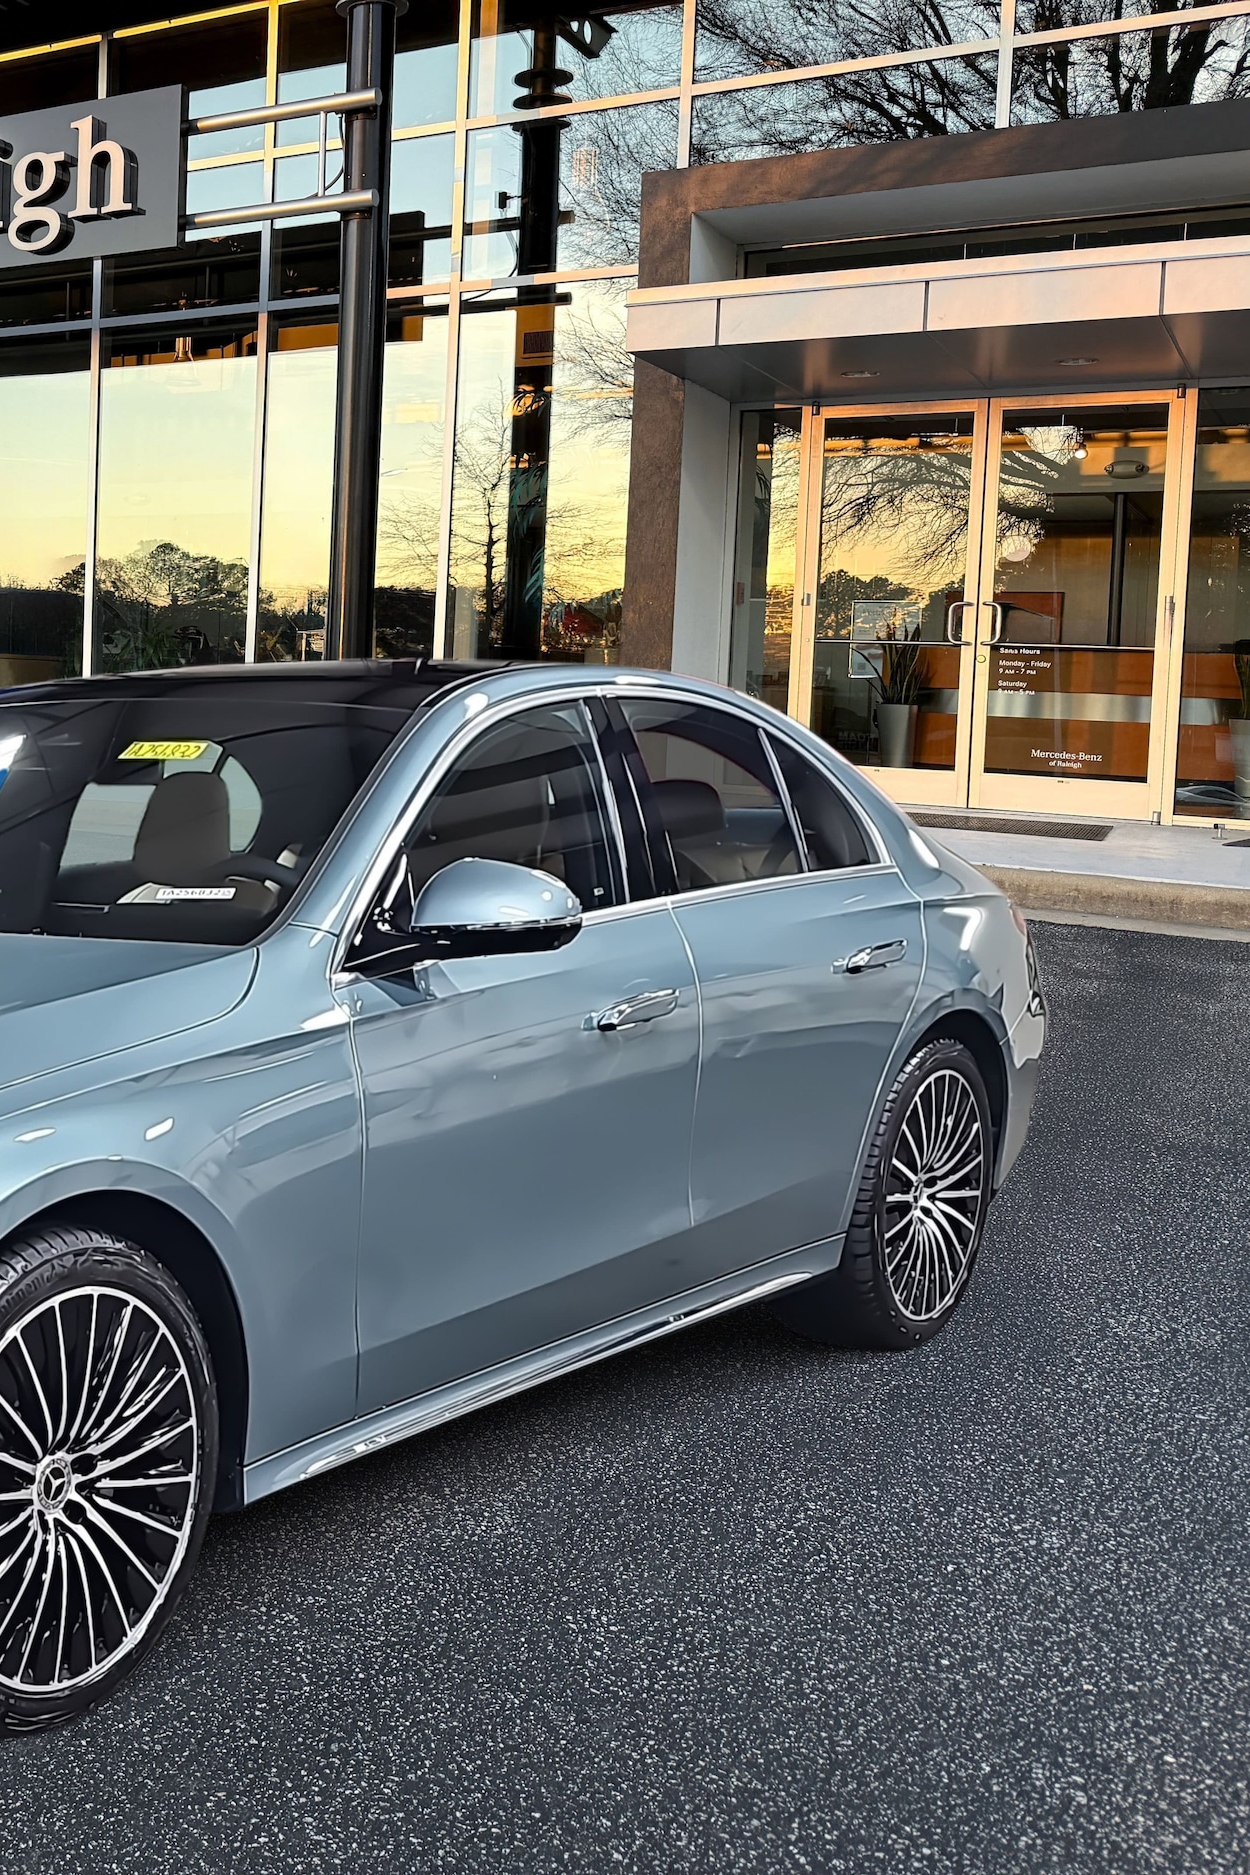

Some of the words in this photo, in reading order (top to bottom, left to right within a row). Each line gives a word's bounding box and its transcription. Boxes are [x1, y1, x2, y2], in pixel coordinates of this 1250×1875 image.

[998, 680, 1027, 688] Saturday
[1031, 749, 1103, 761] Mercedes-Benz
[1057, 760, 1082, 769] Raleigh
